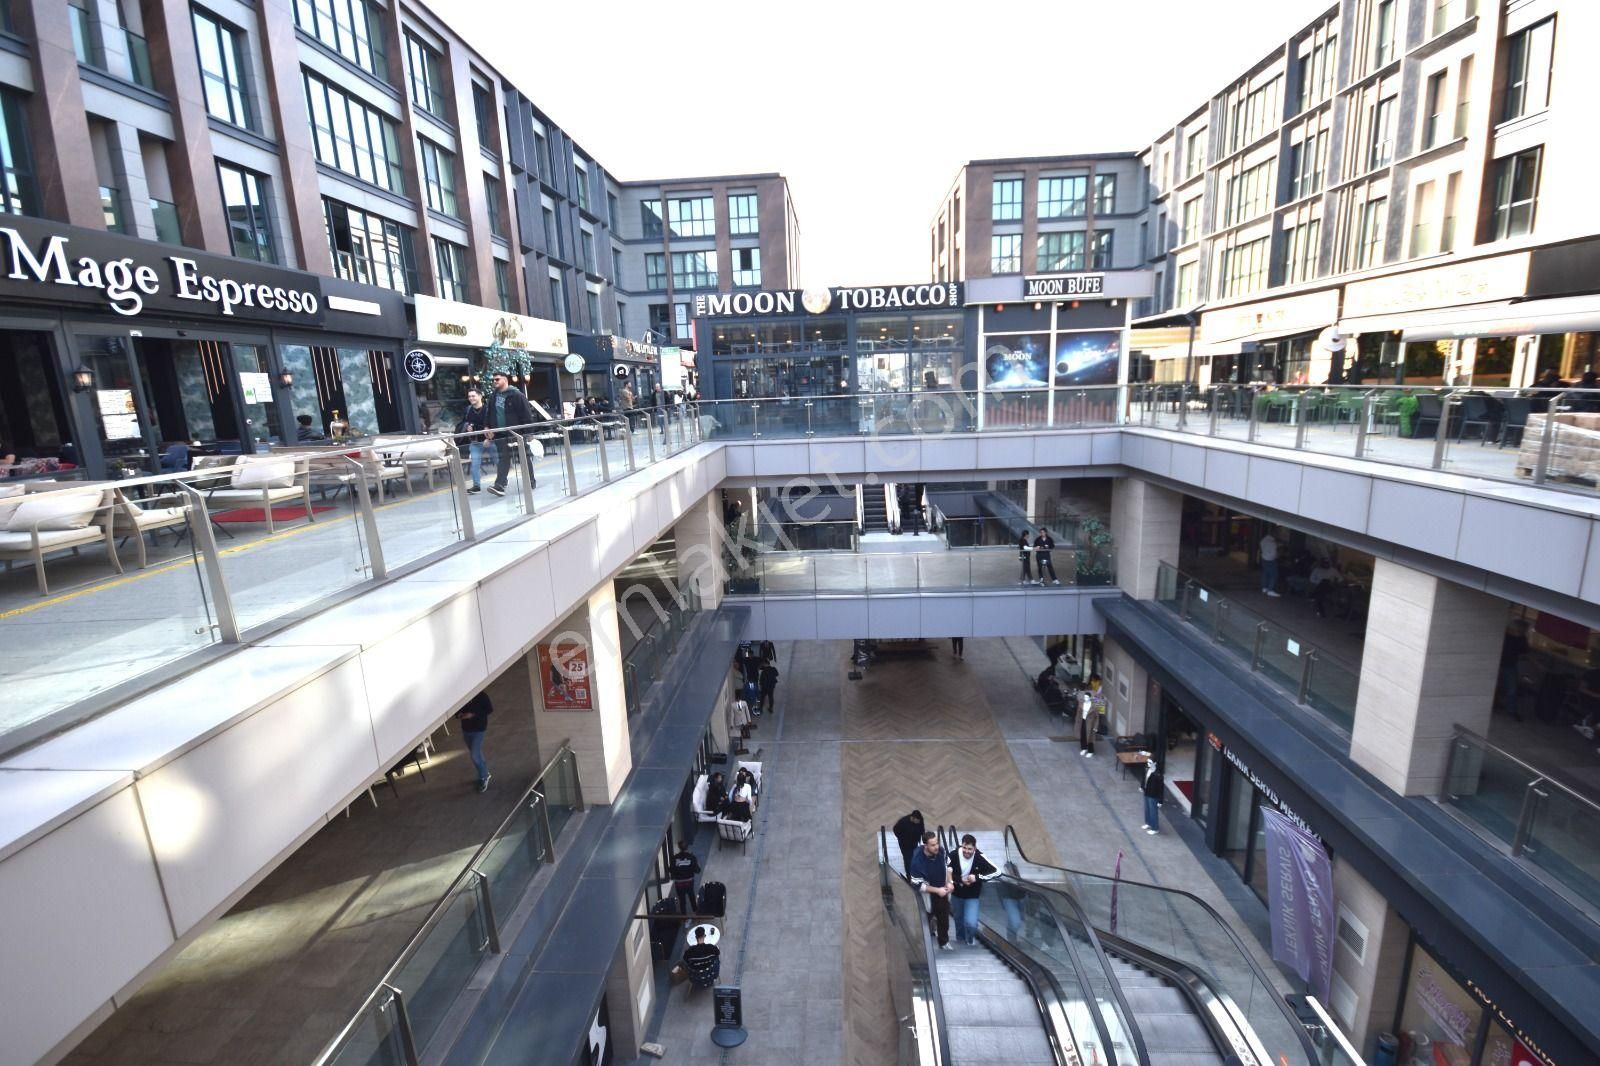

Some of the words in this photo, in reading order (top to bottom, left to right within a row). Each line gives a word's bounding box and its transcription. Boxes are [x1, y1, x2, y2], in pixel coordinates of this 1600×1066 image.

[0, 227, 159, 316] Mage
[169, 256, 318, 315] Espresso
[1028, 279, 1064, 295] MOON
[696, 295, 706, 316] THE
[708, 291, 796, 316] MOON
[836, 284, 946, 309] TOBACCO
[949, 283, 957, 306] SHOP
[1003, 353, 1032, 361] MOON
[571, 663, 583, 672] 25
